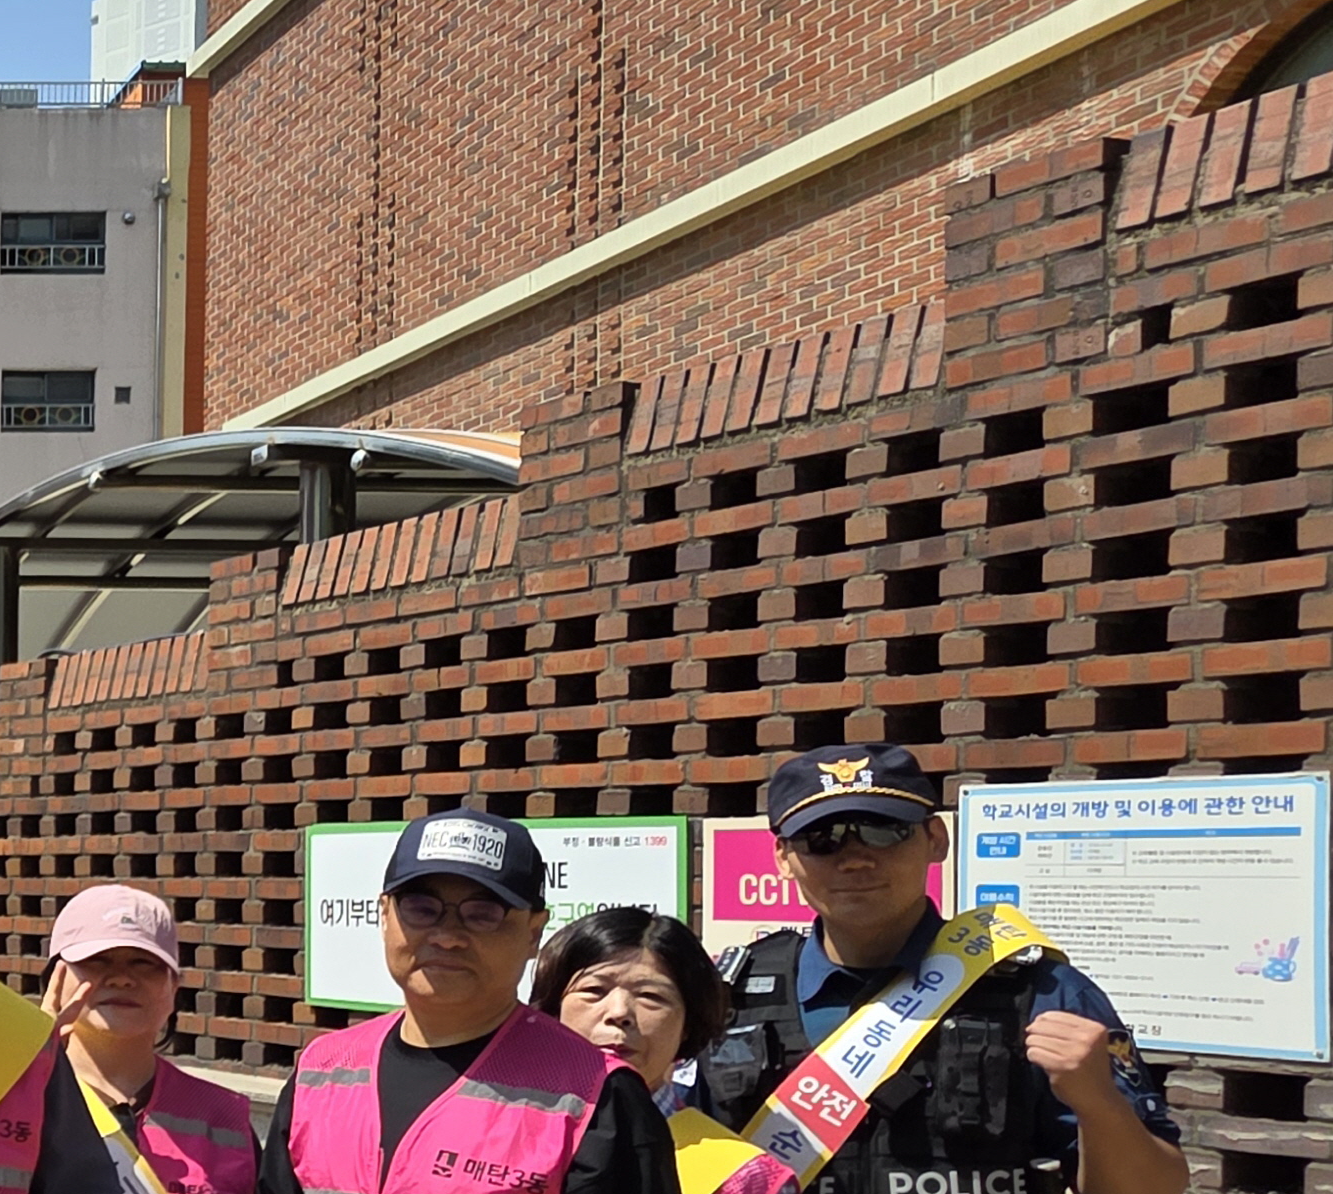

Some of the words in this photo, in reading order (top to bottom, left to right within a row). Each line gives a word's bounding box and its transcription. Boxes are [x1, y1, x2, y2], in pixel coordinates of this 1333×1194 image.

[982, 803, 1067, 821] 학교시설의
[1072, 801, 1109, 819] 개방
[1114, 800, 1132, 818] 및
[1137, 797, 1199, 817] 이용에
[1204, 796, 1245, 816] 관한
[1250, 795, 1295, 815] 안내
[472, 833, 504, 860] 1920
[644, 835, 668, 847] 1399
[543, 861, 568, 889] NE
[320, 899, 380, 927] 여기부터
[947, 926, 995, 956] 3동
[841, 968, 945, 1080] 우리동네
[789, 1074, 858, 1128] 안전
